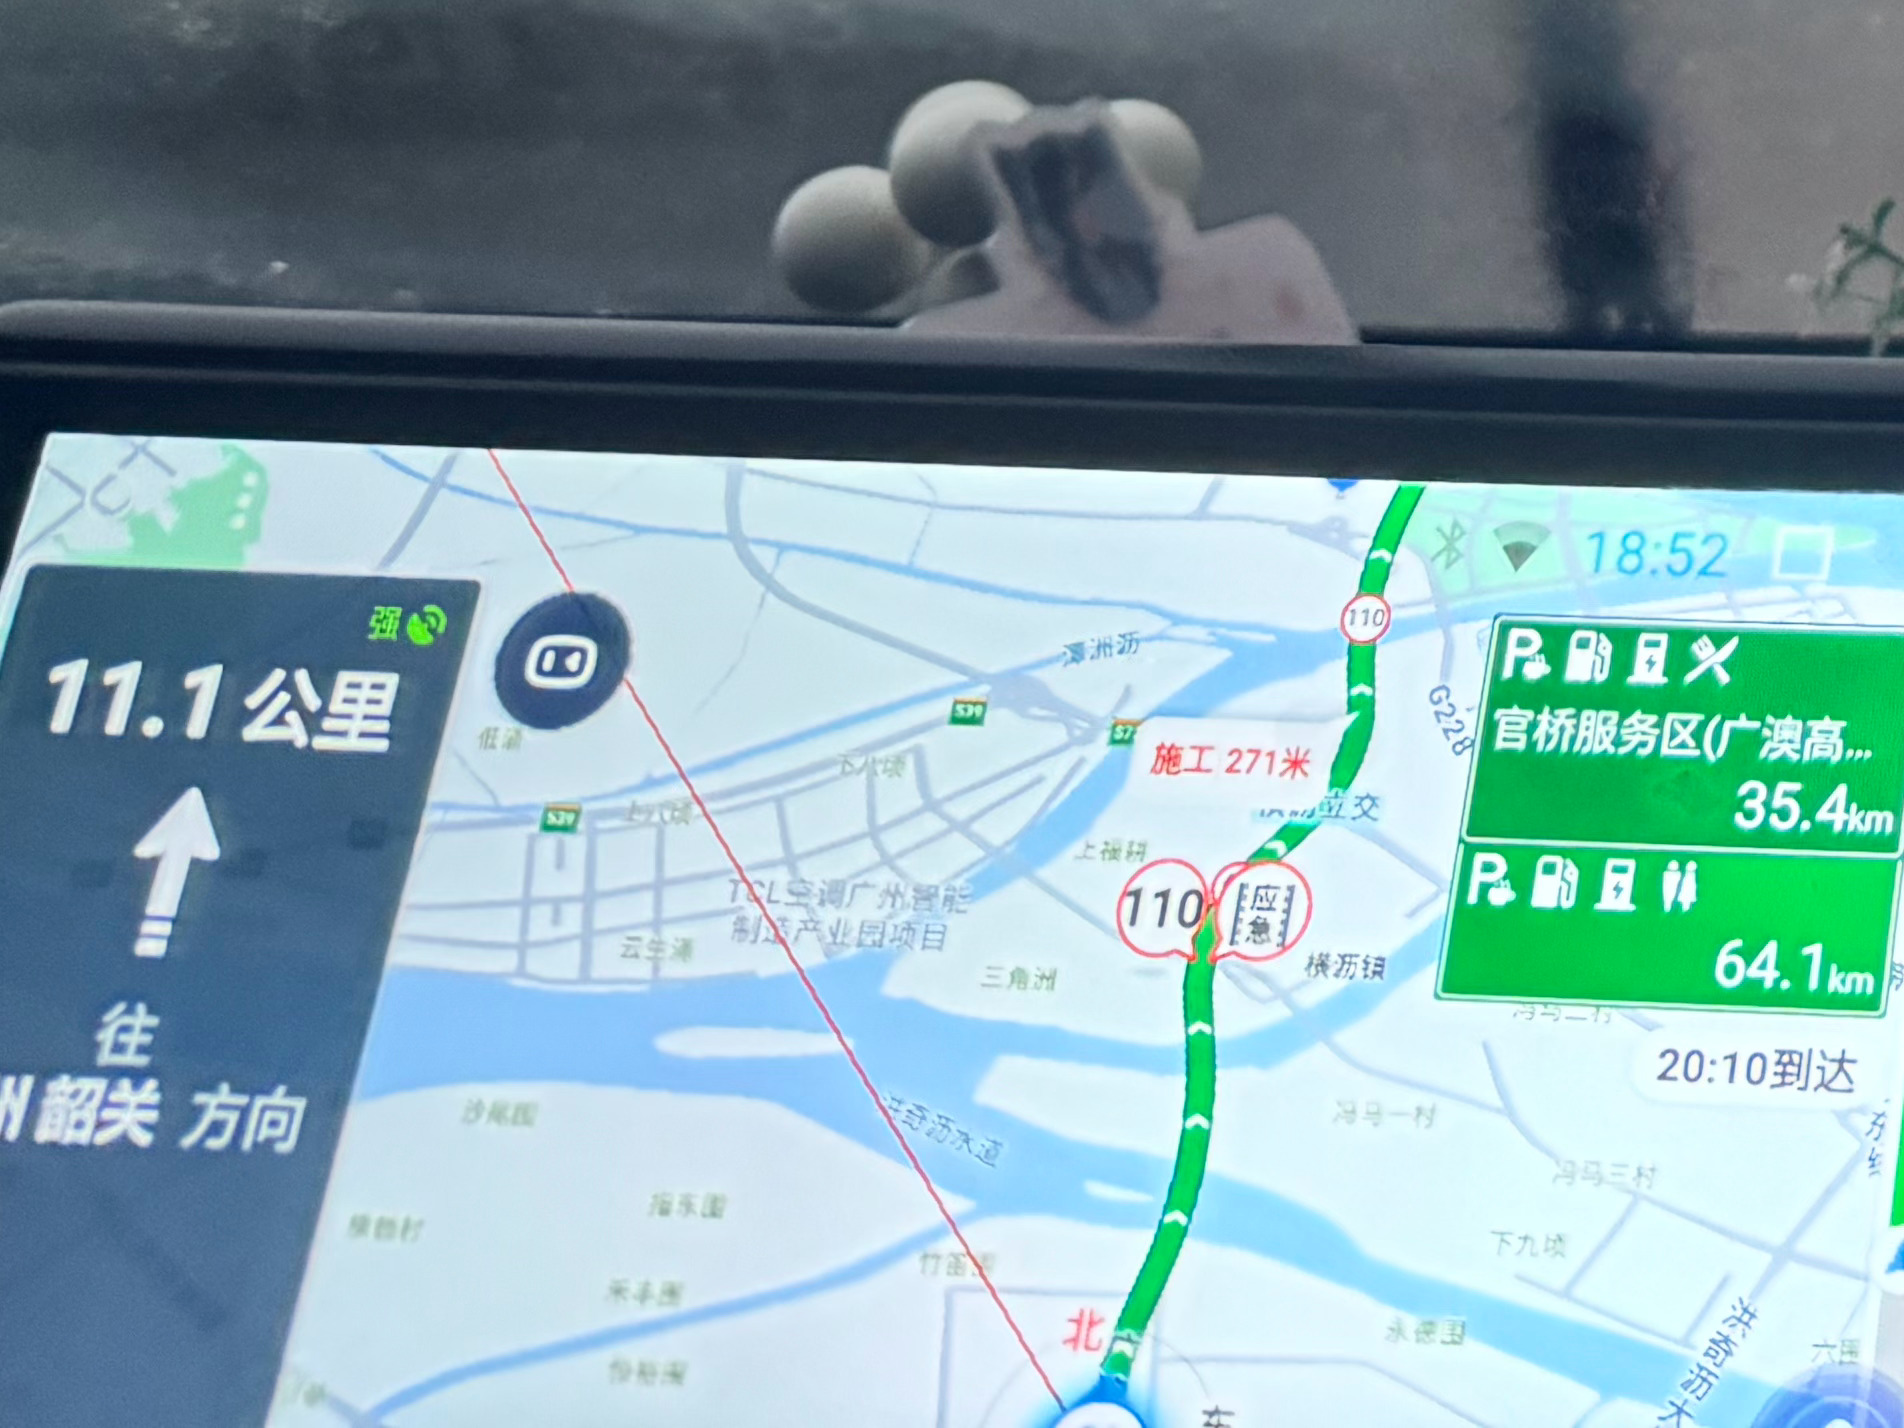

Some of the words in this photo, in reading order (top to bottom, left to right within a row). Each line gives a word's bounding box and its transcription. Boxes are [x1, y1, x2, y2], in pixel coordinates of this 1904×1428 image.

[1586, 528, 1730, 578] 18:52
[367, 605, 402, 641] 强
[1348, 607, 1386, 627] 110
[48, 657, 224, 740] 11.1
[241, 667, 401, 753] 公里
[1428, 683, 1475, 757] G228
[1150, 743, 1215, 777] 施工
[1223, 745, 1312, 780] 271米
[1733, 779, 1896, 836] 35.4km
[1124, 887, 1206, 928] 110
[1245, 883, 1281, 944] 应急
[980, 966, 1058, 992] 三角洲
[1304, 952, 1387, 981] 横沥镇
[1714, 938, 1876, 996] 64.1km
[95, 1001, 160, 1067] 往
[1656, 1048, 1858, 1093] 20:10到达
[180, 1081, 307, 1154] 方向
[1062, 1308, 1106, 1353] 北
